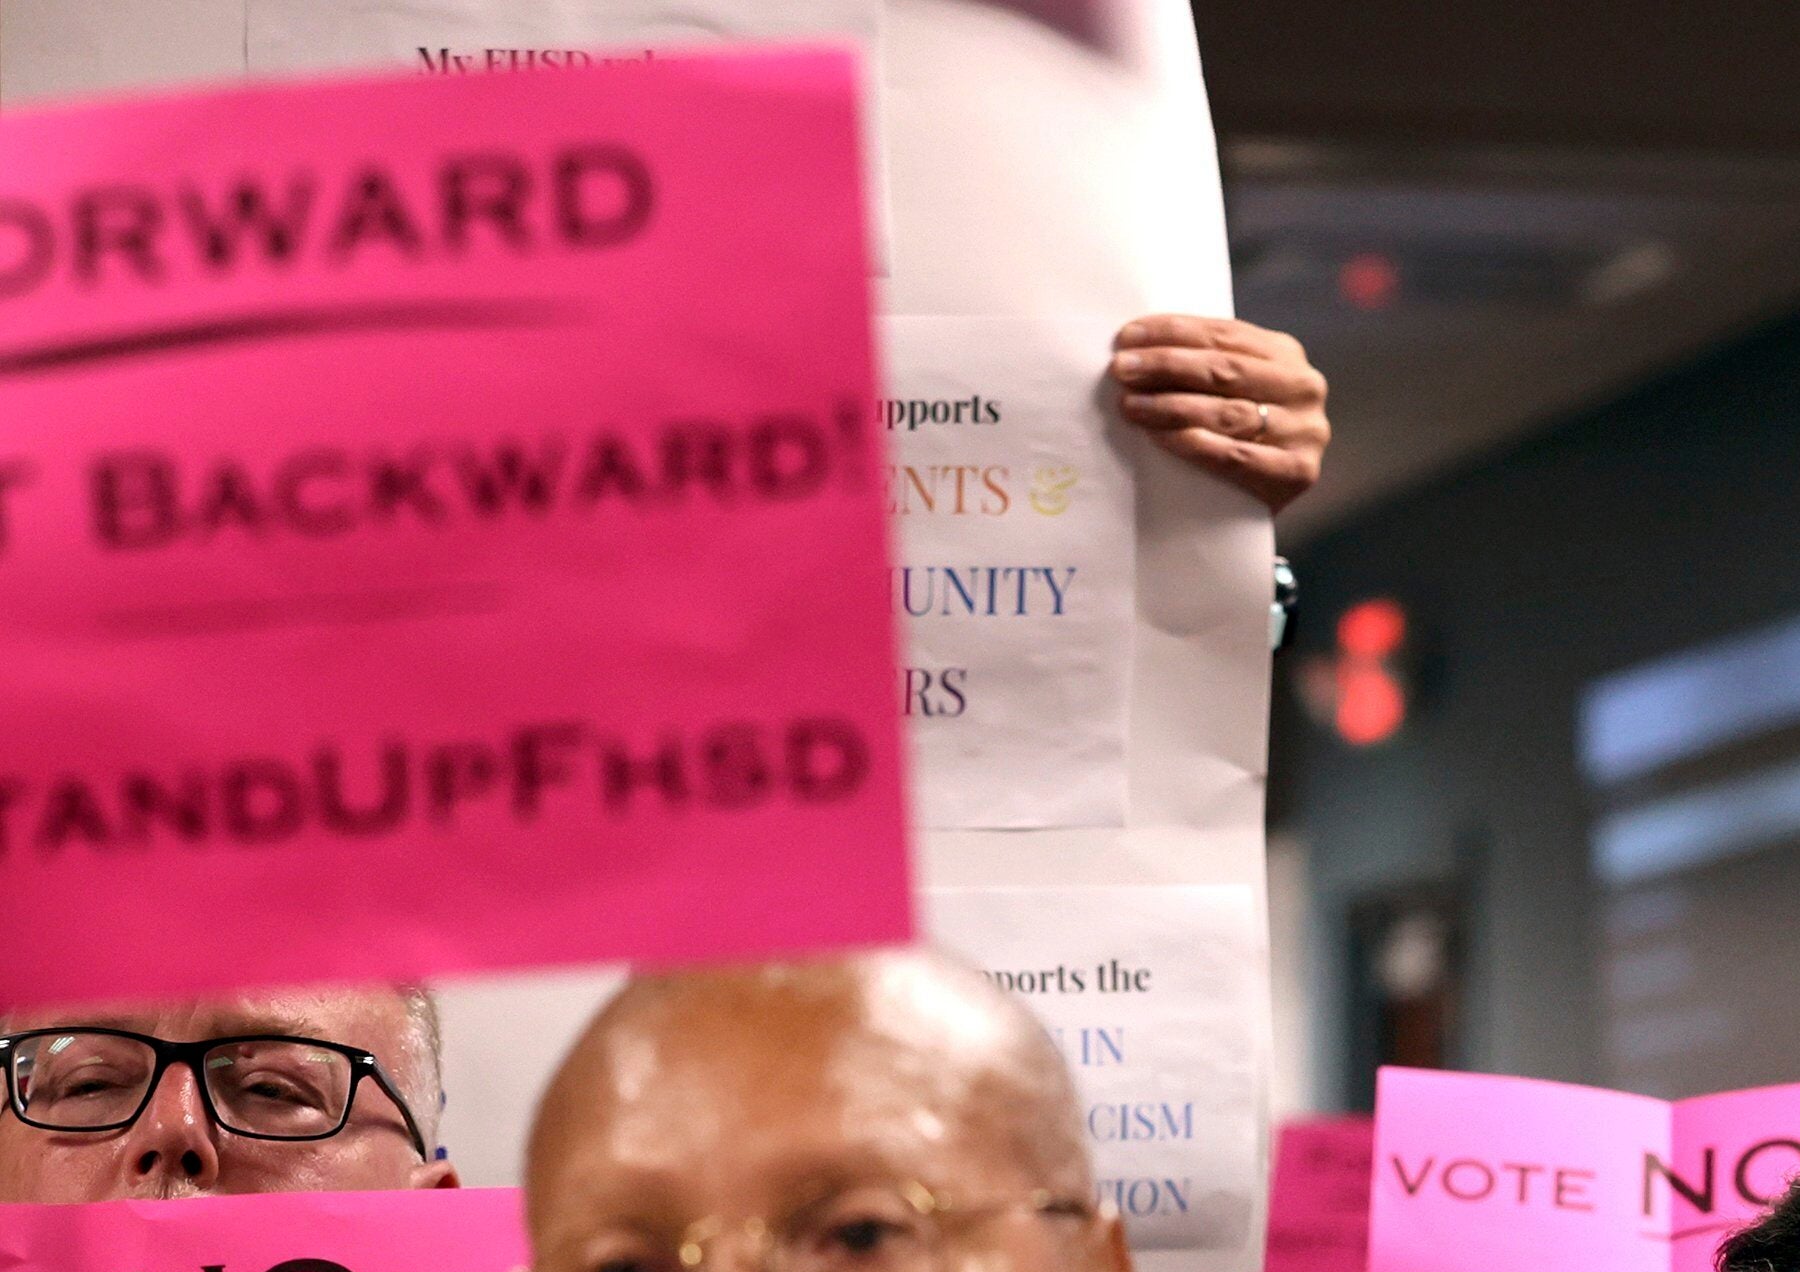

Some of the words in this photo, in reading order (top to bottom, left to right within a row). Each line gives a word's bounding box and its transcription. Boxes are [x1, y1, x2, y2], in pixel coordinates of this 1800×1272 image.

[890, 566, 1077, 616] UNITY
[1096, 957, 1152, 993] the
[1391, 1156, 1598, 1212] VOTE
